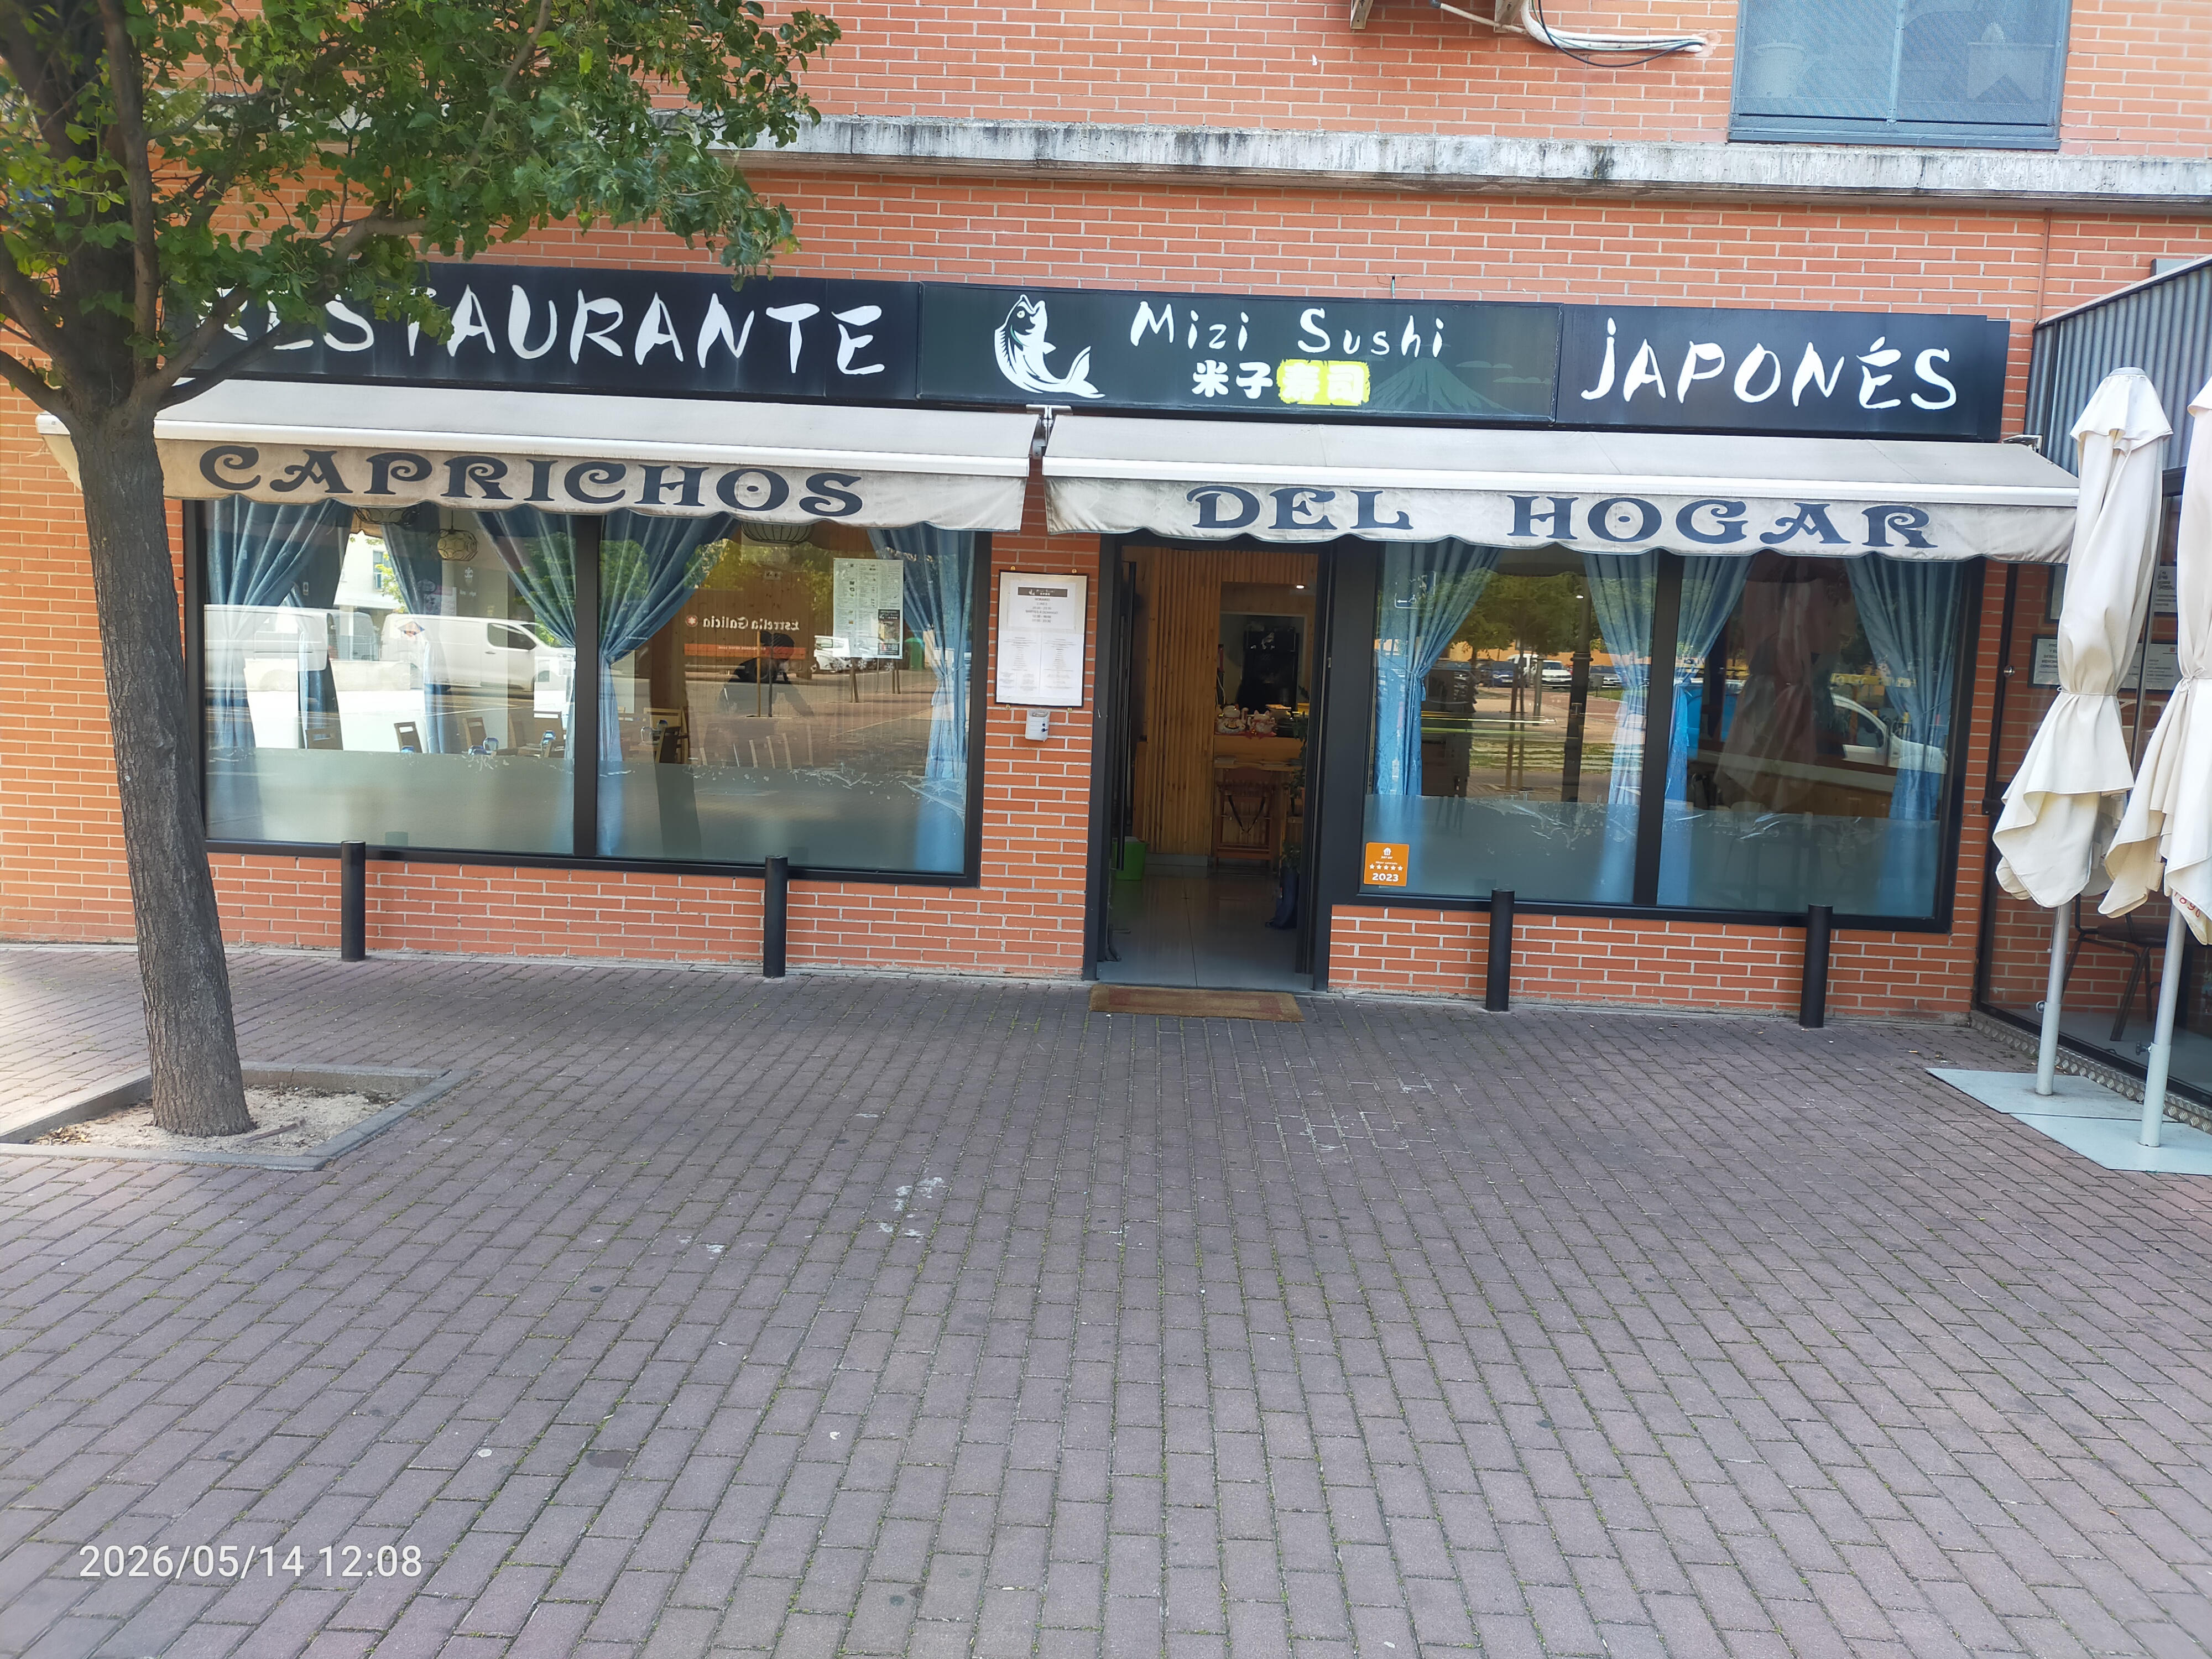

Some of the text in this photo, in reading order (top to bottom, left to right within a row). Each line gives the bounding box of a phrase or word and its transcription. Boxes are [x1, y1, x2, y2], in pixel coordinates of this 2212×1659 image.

[1130, 301, 1445, 358] Mizi Sushi
[200, 445, 863, 517] CAPRICHOS
[1186, 485, 1939, 549] DEL HOGAR
[1372, 873, 1399, 881] 2023
